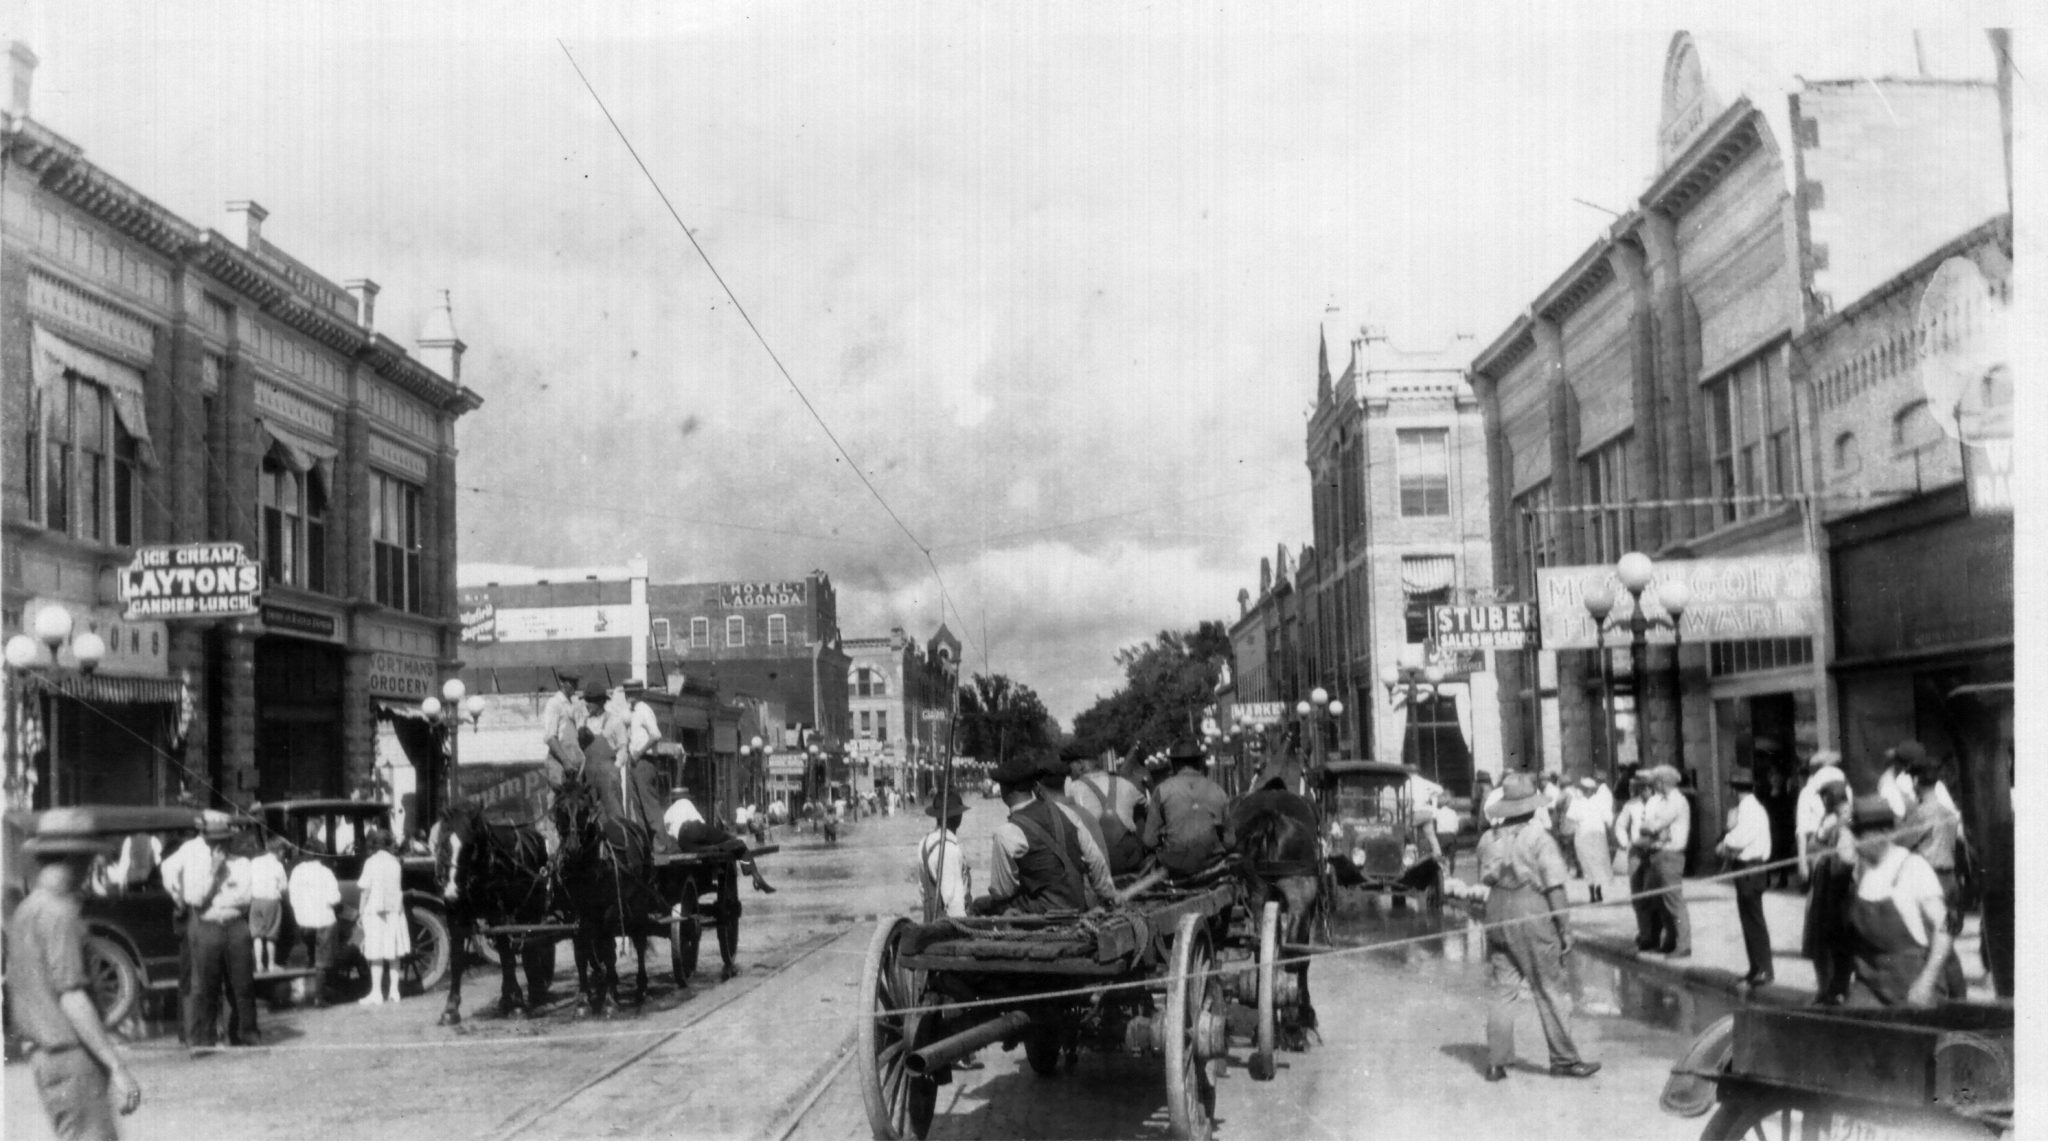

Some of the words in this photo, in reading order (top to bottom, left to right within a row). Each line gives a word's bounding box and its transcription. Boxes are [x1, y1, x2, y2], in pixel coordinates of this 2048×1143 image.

[143, 549, 170, 566] ICE
[176, 546, 236, 565] CREAM
[121, 566, 257, 598] LAYTONS
[731, 583, 793, 596] HOTEL
[721, 592, 801, 608] LAGONDA
[1438, 603, 1539, 632] STUBER
